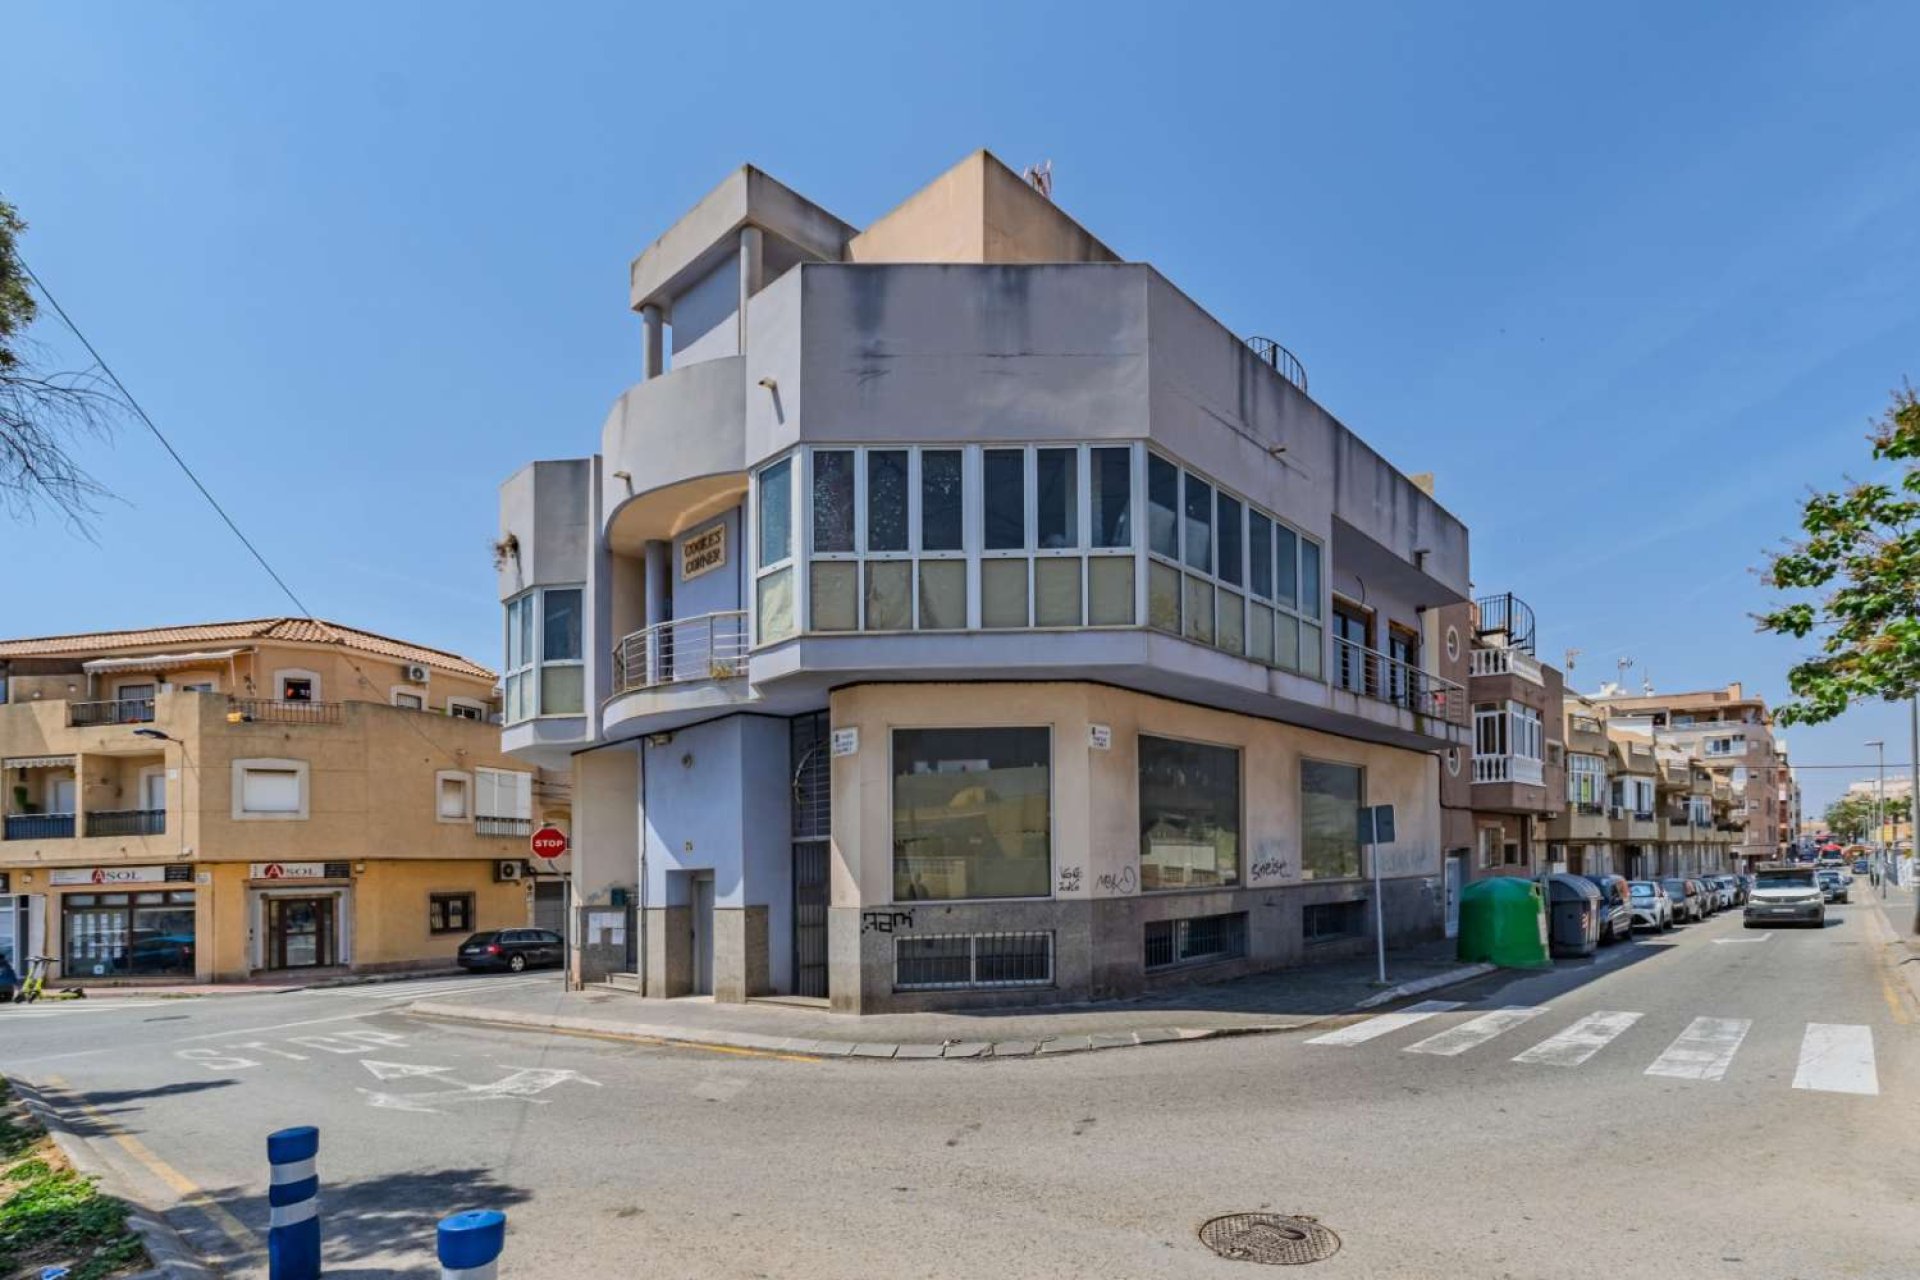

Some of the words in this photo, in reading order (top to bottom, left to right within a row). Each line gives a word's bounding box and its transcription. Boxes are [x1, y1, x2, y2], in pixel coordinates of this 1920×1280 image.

[535, 839, 563, 848] STOP
[92, 868, 141, 883] ASOL
[264, 864, 316, 878] ASOL
[175, 1030, 411, 1071] STOP
